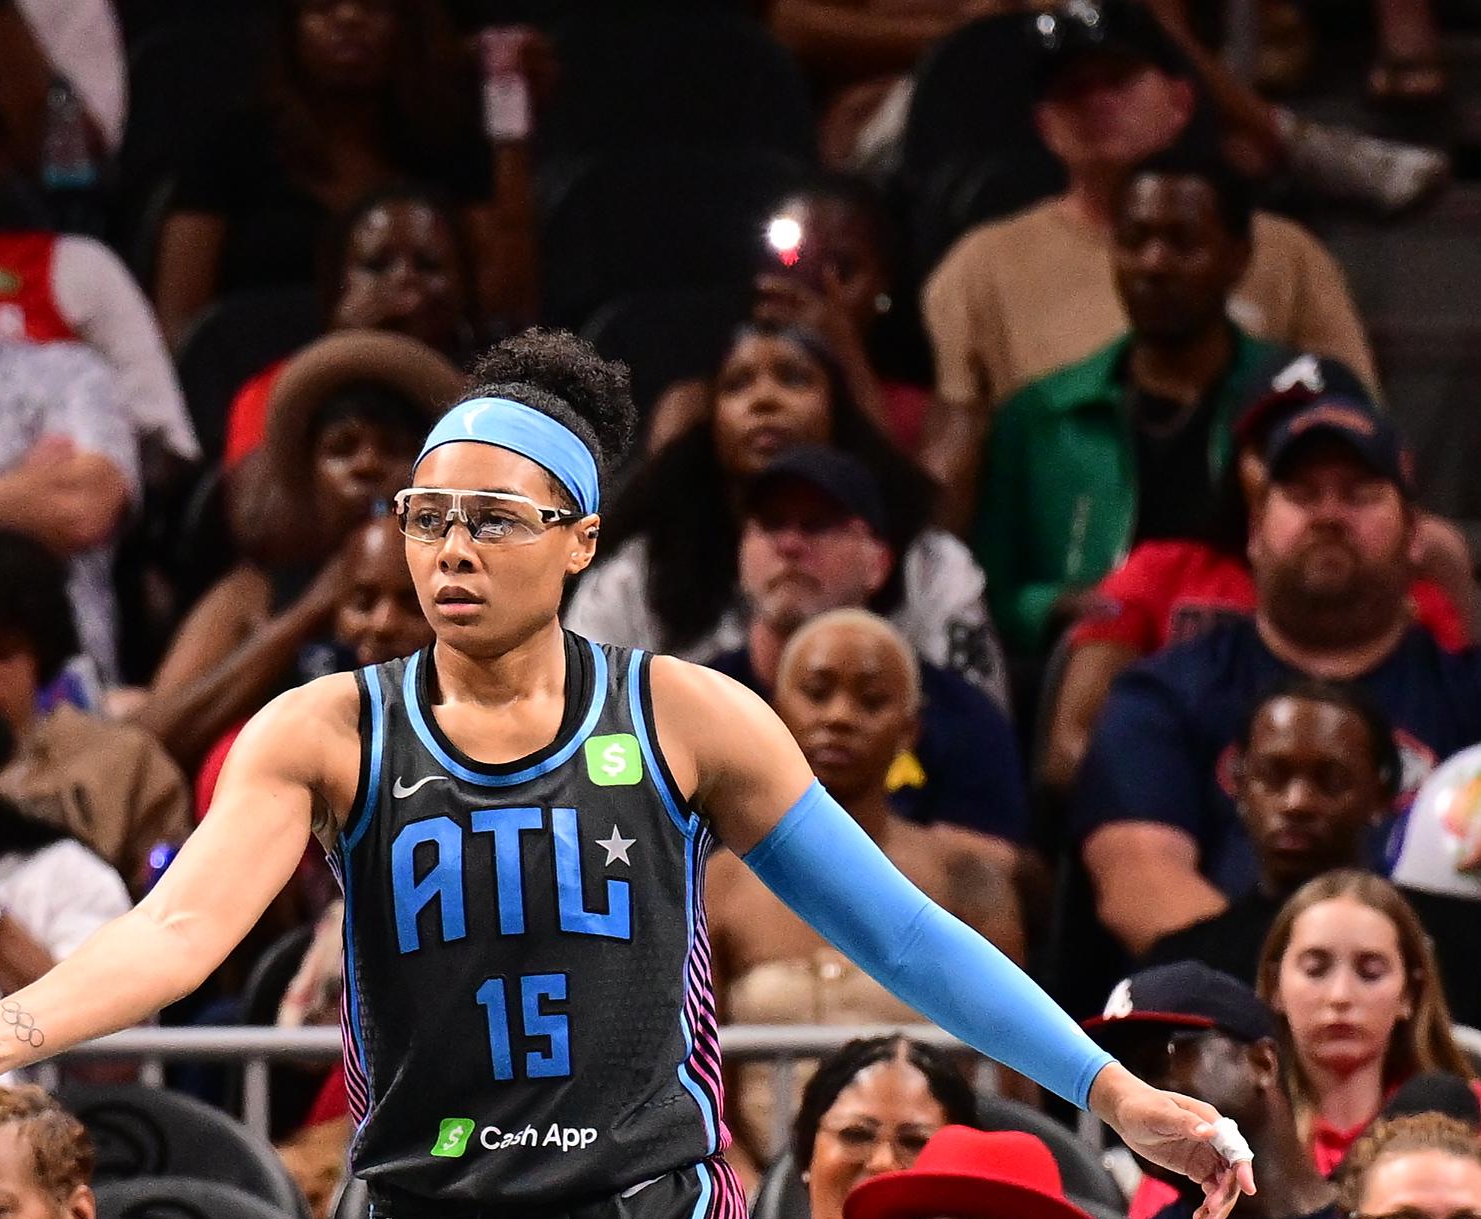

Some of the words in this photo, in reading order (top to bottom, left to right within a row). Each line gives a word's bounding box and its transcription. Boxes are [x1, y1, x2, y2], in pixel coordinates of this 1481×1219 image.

[391, 807, 631, 955] ATL
[476, 974, 571, 1081] 15
[480, 1123, 538, 1151] Cash
[542, 1122, 598, 1152] App
